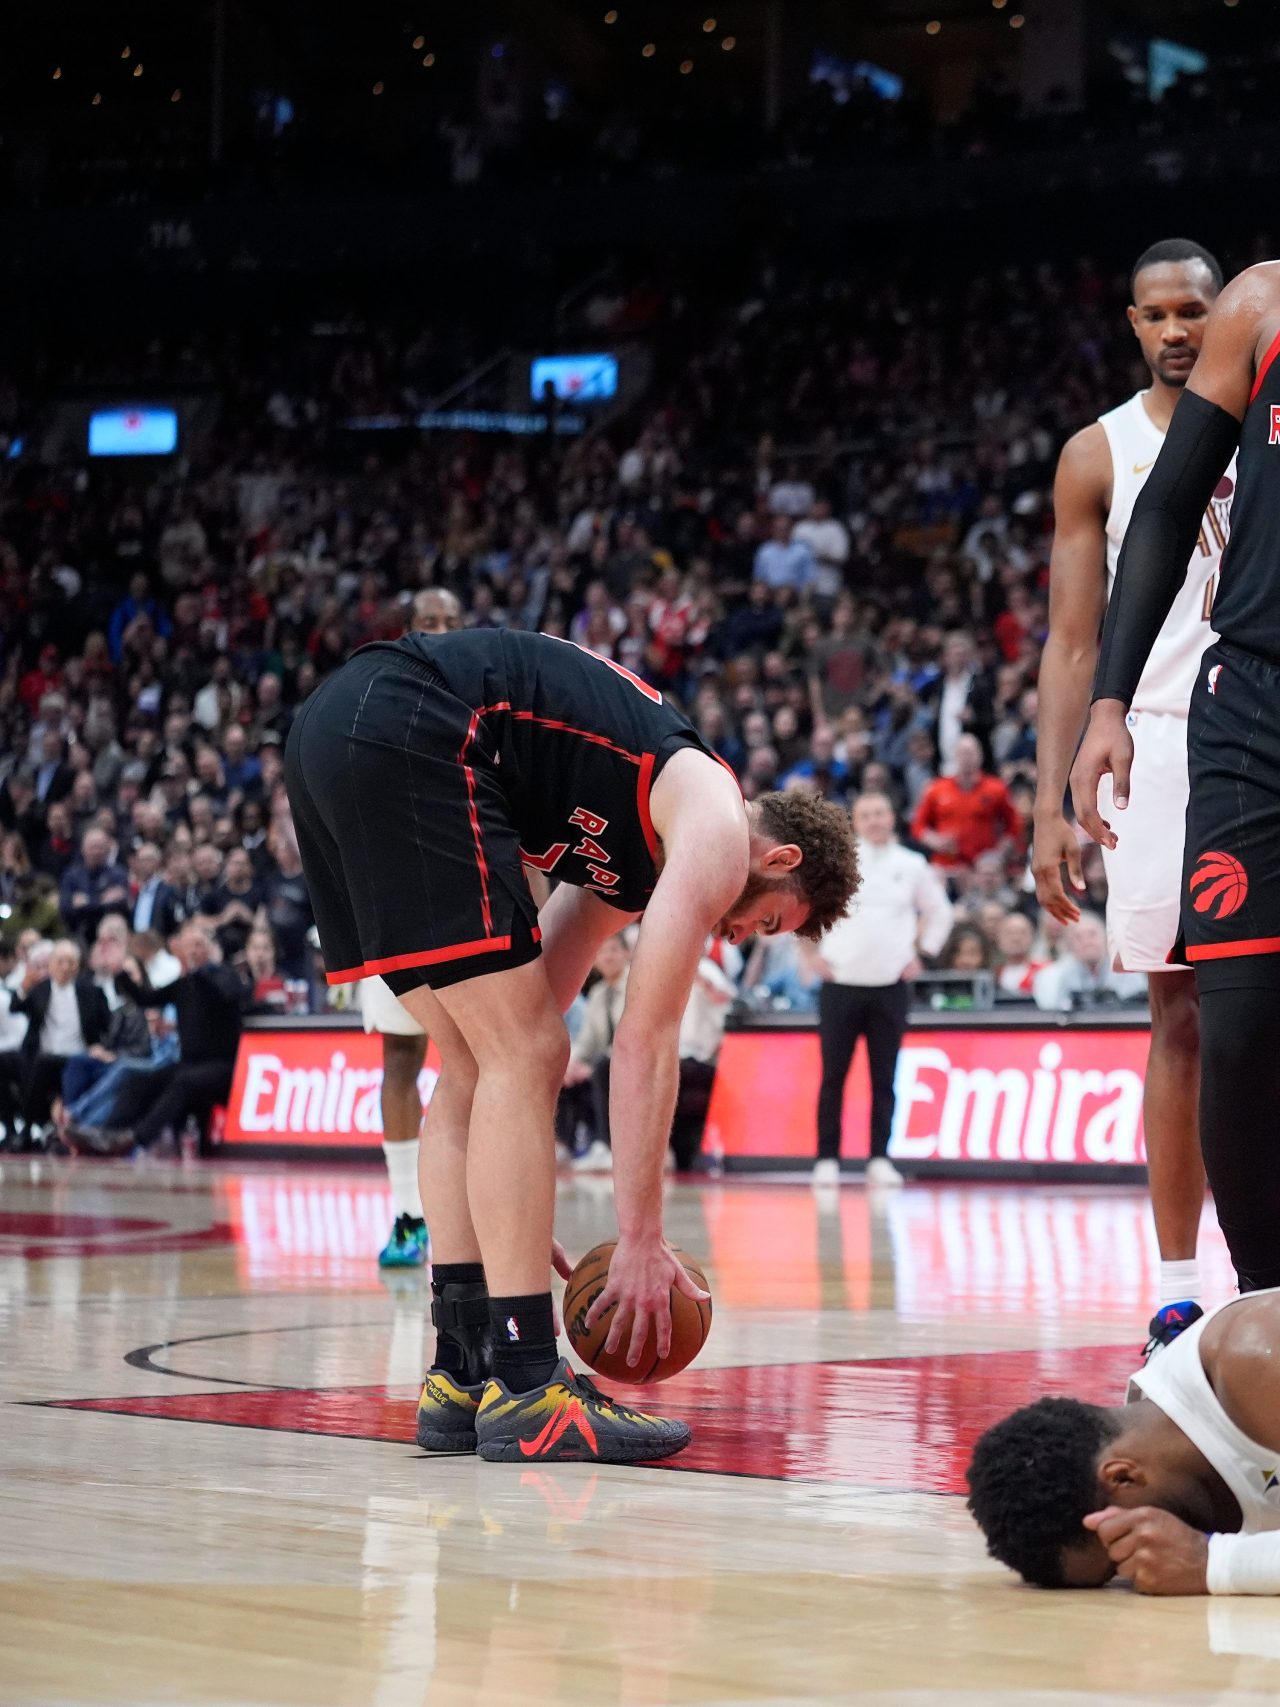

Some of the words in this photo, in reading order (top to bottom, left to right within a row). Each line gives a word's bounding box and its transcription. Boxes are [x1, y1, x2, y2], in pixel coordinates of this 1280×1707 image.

[568, 806, 620, 895] RAP
[239, 1051, 440, 1133] Emira
[886, 1042, 1147, 1163] Emira
[427, 1380, 449, 1405] TWELVE
